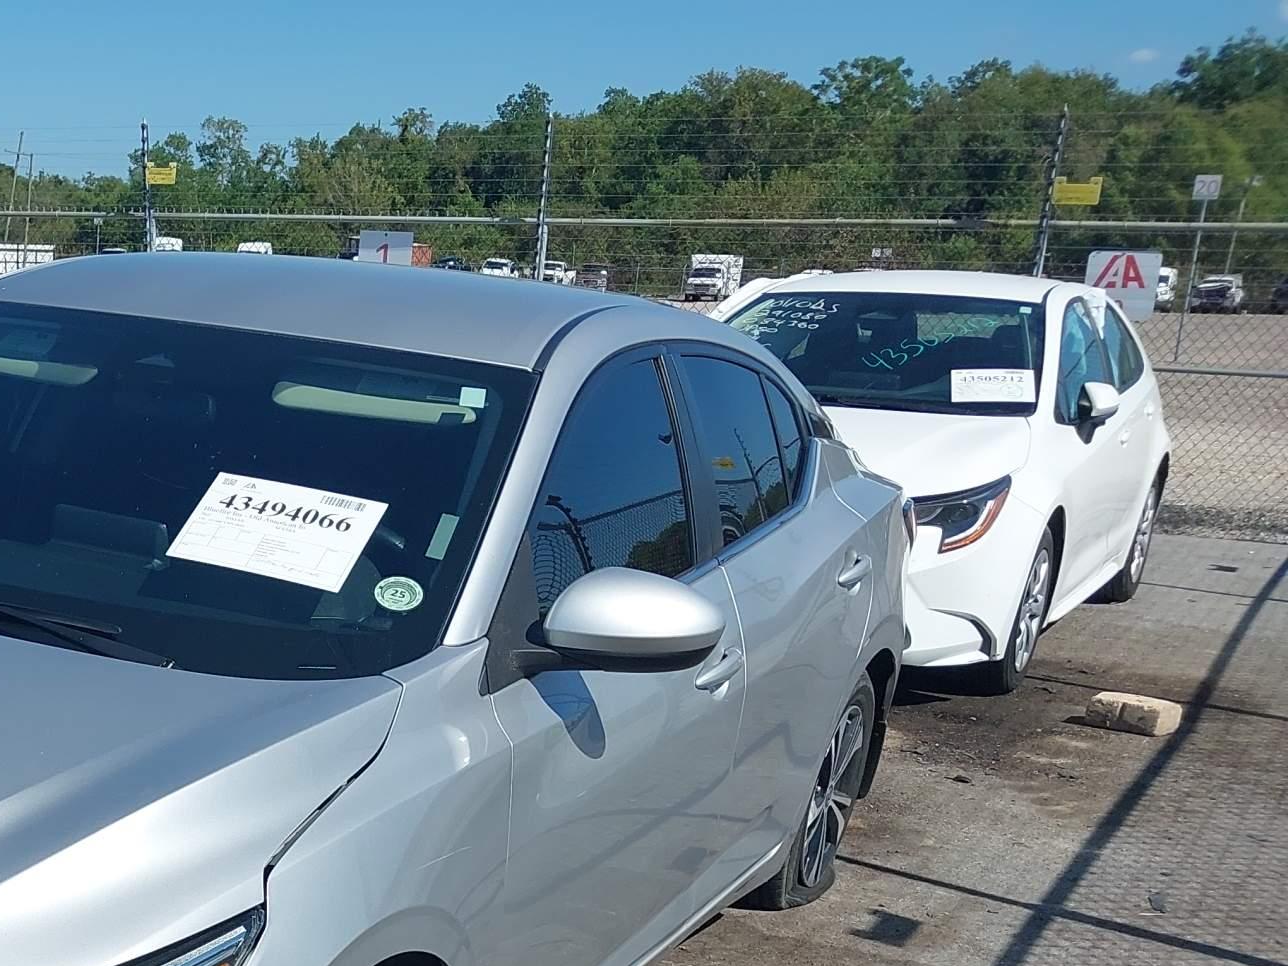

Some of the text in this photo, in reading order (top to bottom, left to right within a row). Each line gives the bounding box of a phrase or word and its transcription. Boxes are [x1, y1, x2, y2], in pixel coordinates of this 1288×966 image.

[376, 243, 389, 264] 1
[219, 494, 356, 533] 43494066
[390, 589, 406, 598] 25
